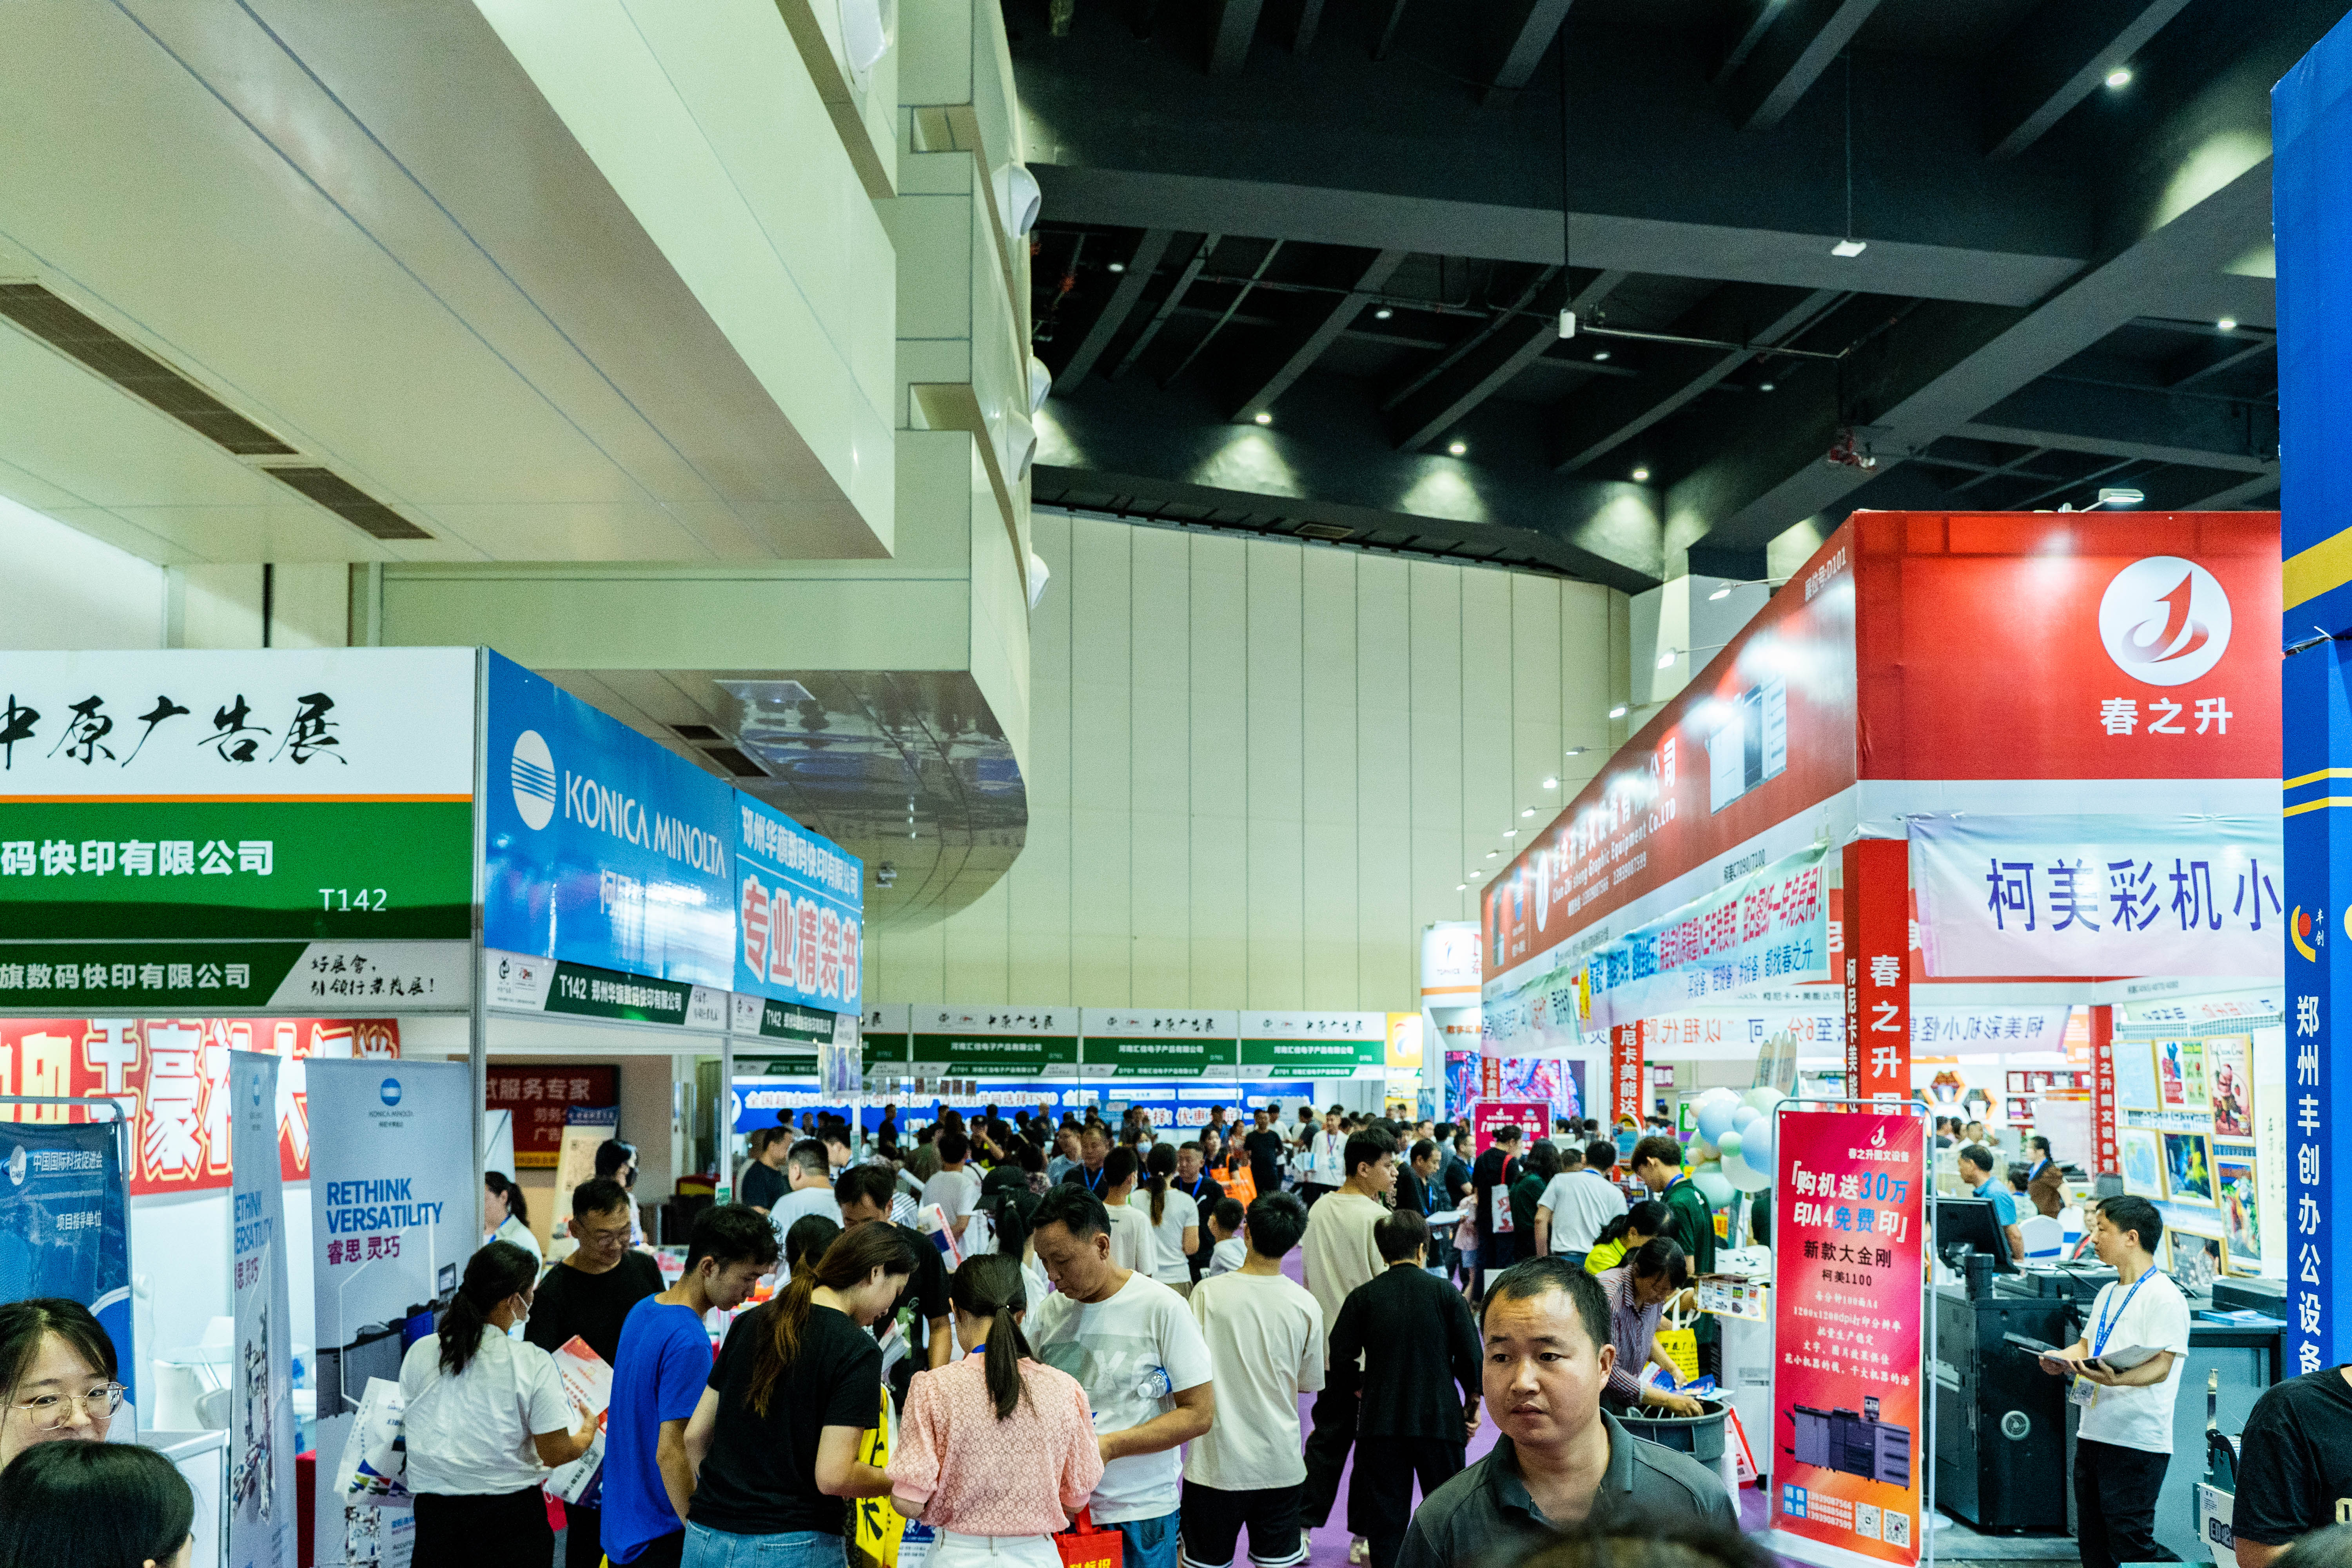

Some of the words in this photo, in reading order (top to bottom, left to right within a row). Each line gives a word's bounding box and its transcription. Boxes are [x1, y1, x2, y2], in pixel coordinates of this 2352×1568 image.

[0, 692, 347, 770] 中原广告展
[2100, 697, 2233, 735] 春之升
[566, 770, 648, 848] KONICA
[654, 812, 726, 878] MINOLTA
[2, 840, 273, 876] 码快印有限公司
[319, 889, 387, 911] T142
[1986, 858, 2281, 932] 柯美彩机小
[2315, 908, 2325, 946] 丰创
[0, 962, 250, 989] 旗数码快印有限公司
[560, 975, 586, 999] T142
[327, 1178, 412, 1206] RETHINK
[2296, 995, 2321, 1375] 郑州丰创办公设备
[56, 1210, 102, 1230] 项目指导单位
[327, 1202, 444, 1234] VERSATILITY
[327, 1240, 362, 1265] 睿思
[367, 1235, 401, 1261] 灵巧
[1804, 1240, 1891, 1268] 新款大金刚
[1822, 1269, 1872, 1286] 柯美1100
